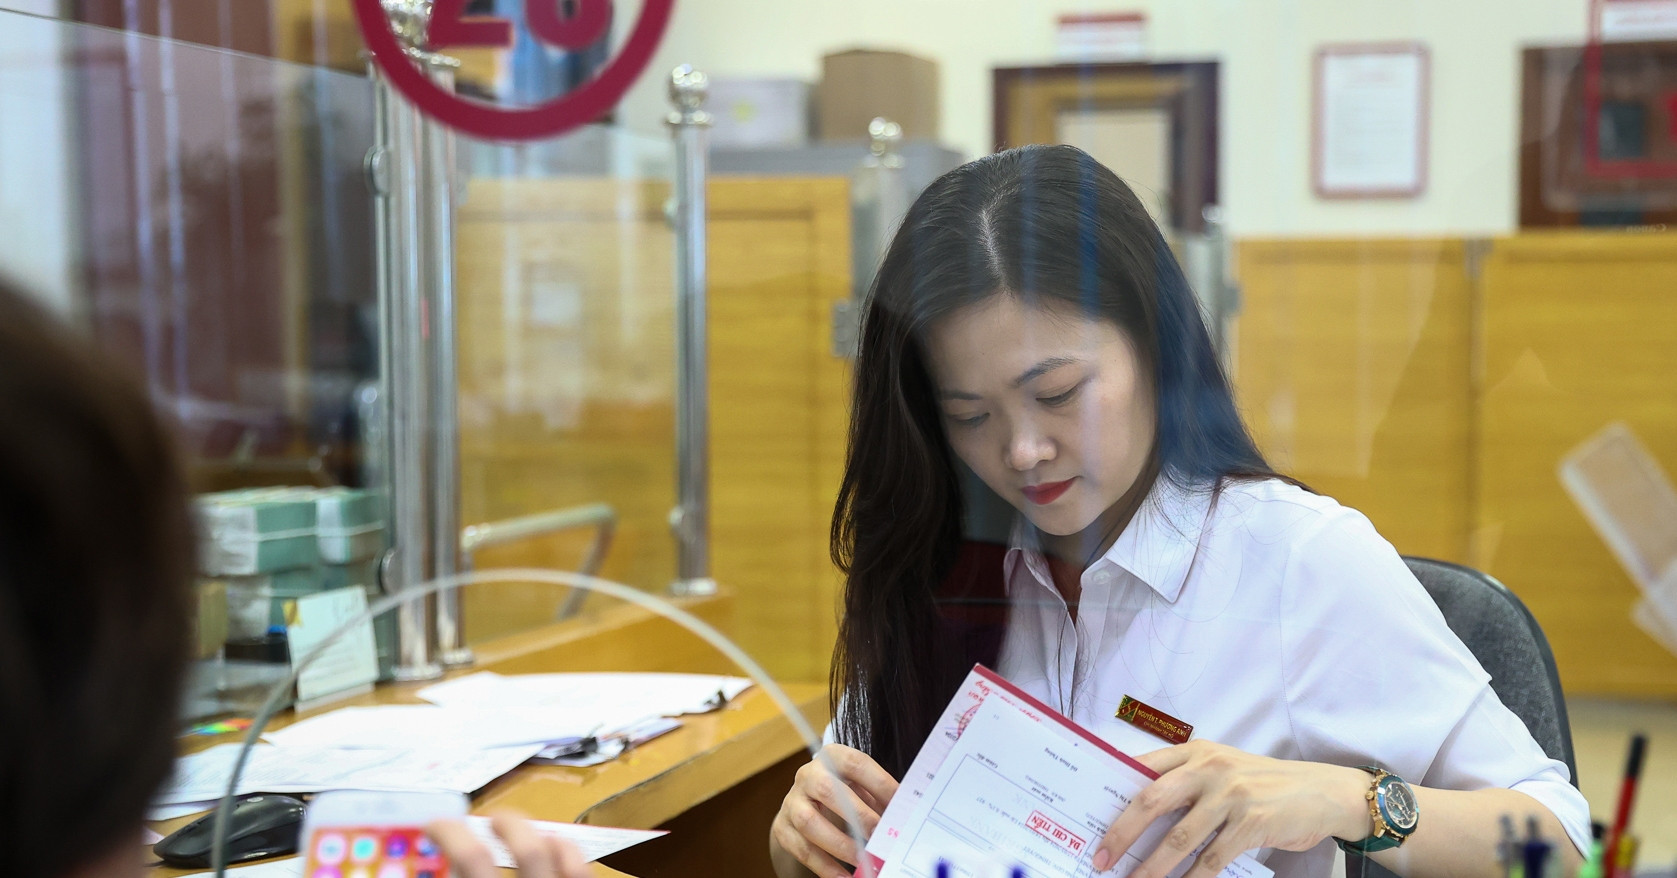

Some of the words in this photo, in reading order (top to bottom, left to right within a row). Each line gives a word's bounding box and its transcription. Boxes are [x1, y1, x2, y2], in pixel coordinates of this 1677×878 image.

[1029, 815, 1052, 836] TIỀN
[1052, 828, 1068, 842] CHI
[1066, 838, 1082, 852] ĐÃ
